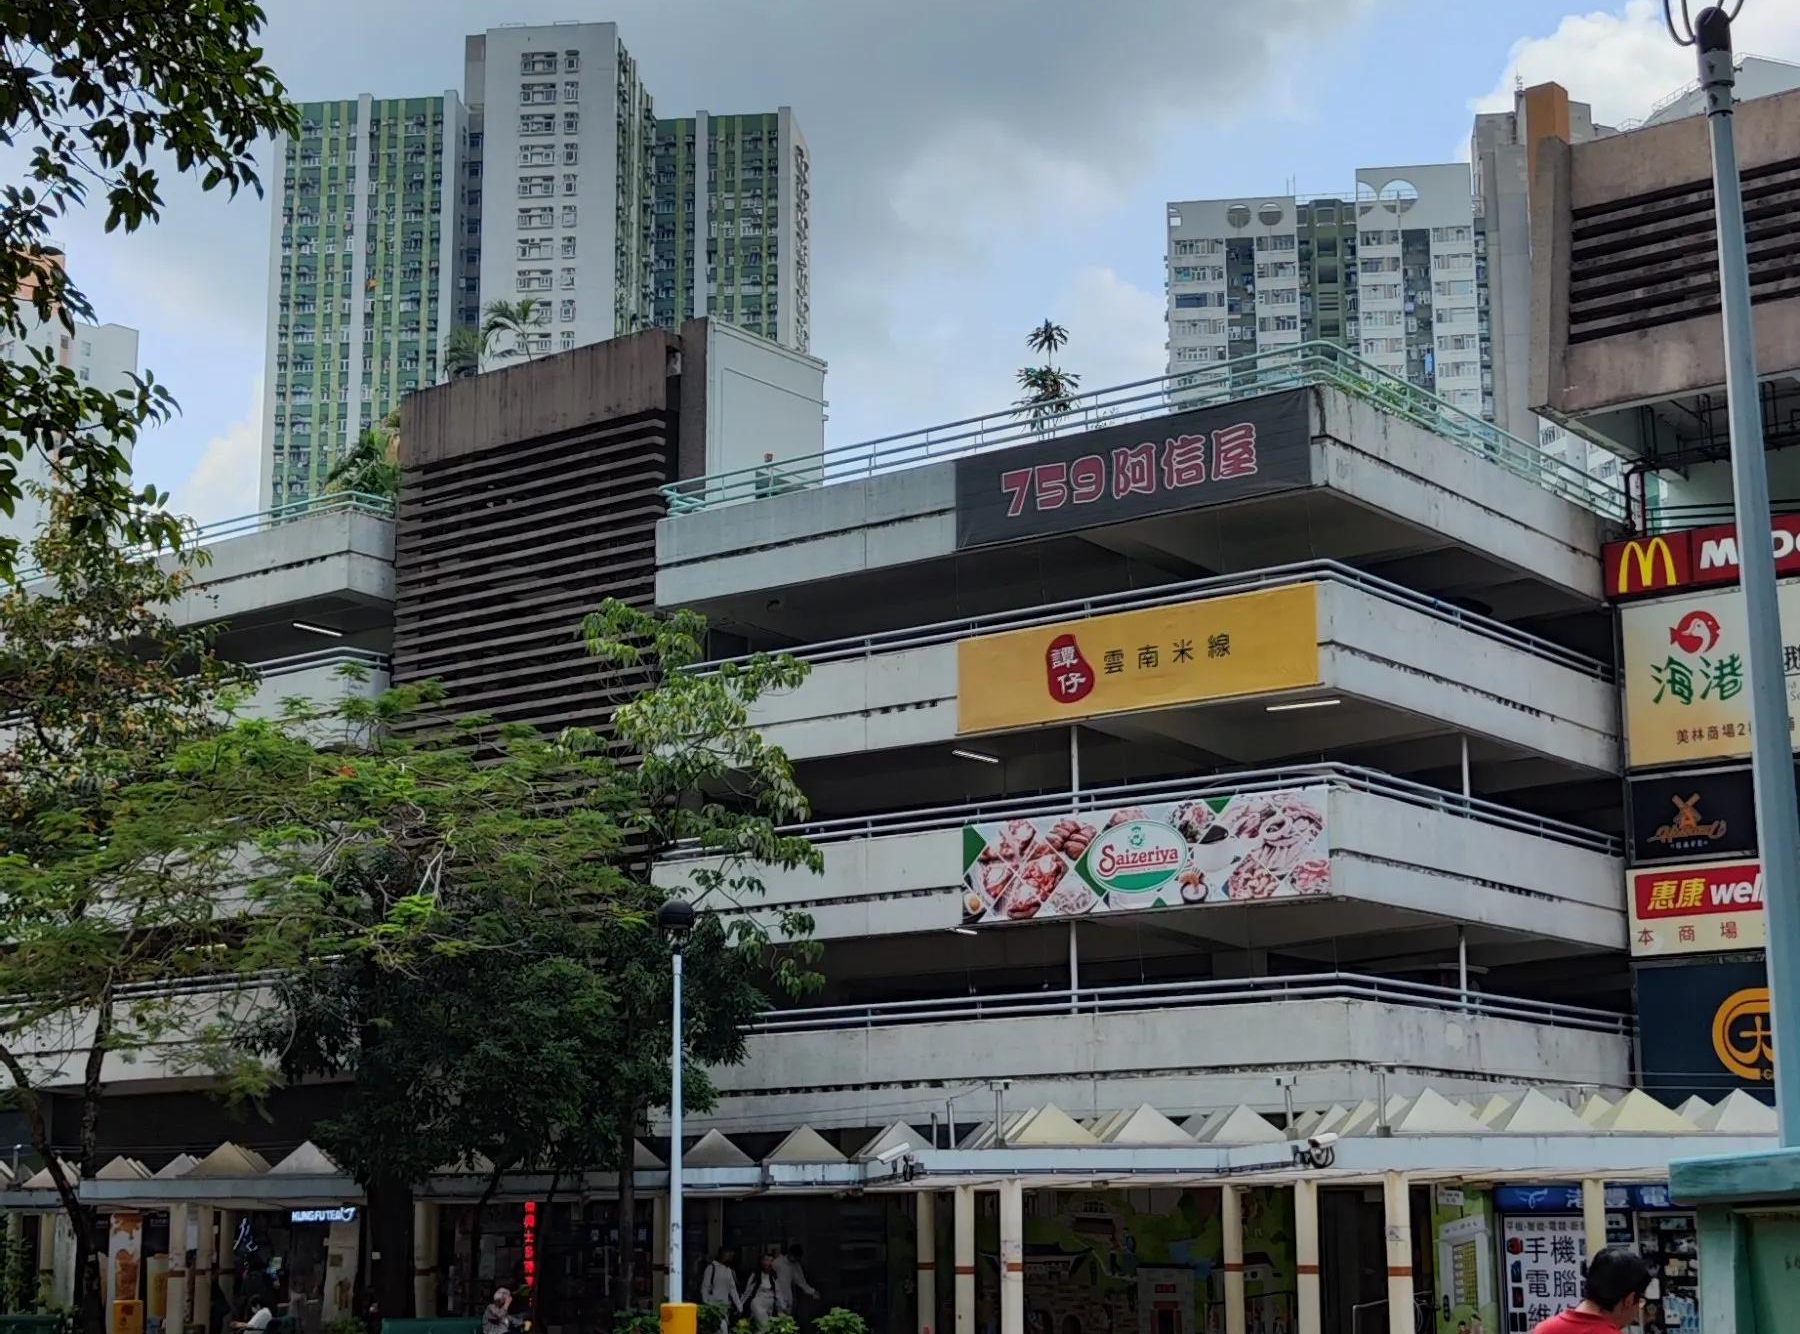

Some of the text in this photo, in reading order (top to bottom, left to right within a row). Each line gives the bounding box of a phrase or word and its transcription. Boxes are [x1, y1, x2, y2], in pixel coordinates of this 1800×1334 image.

[1001, 423, 1257, 517] 759阿信屋
[1051, 646, 1087, 695] 譚仔
[1104, 633, 1231, 675] 雲南米線
[1650, 653, 1743, 706] 海港
[1099, 844, 1179, 873] Saizeriya
[1647, 877, 1706, 911] 惠康
[1525, 1235, 1577, 1265] 手機
[1525, 1269, 1578, 1298] 電腦
